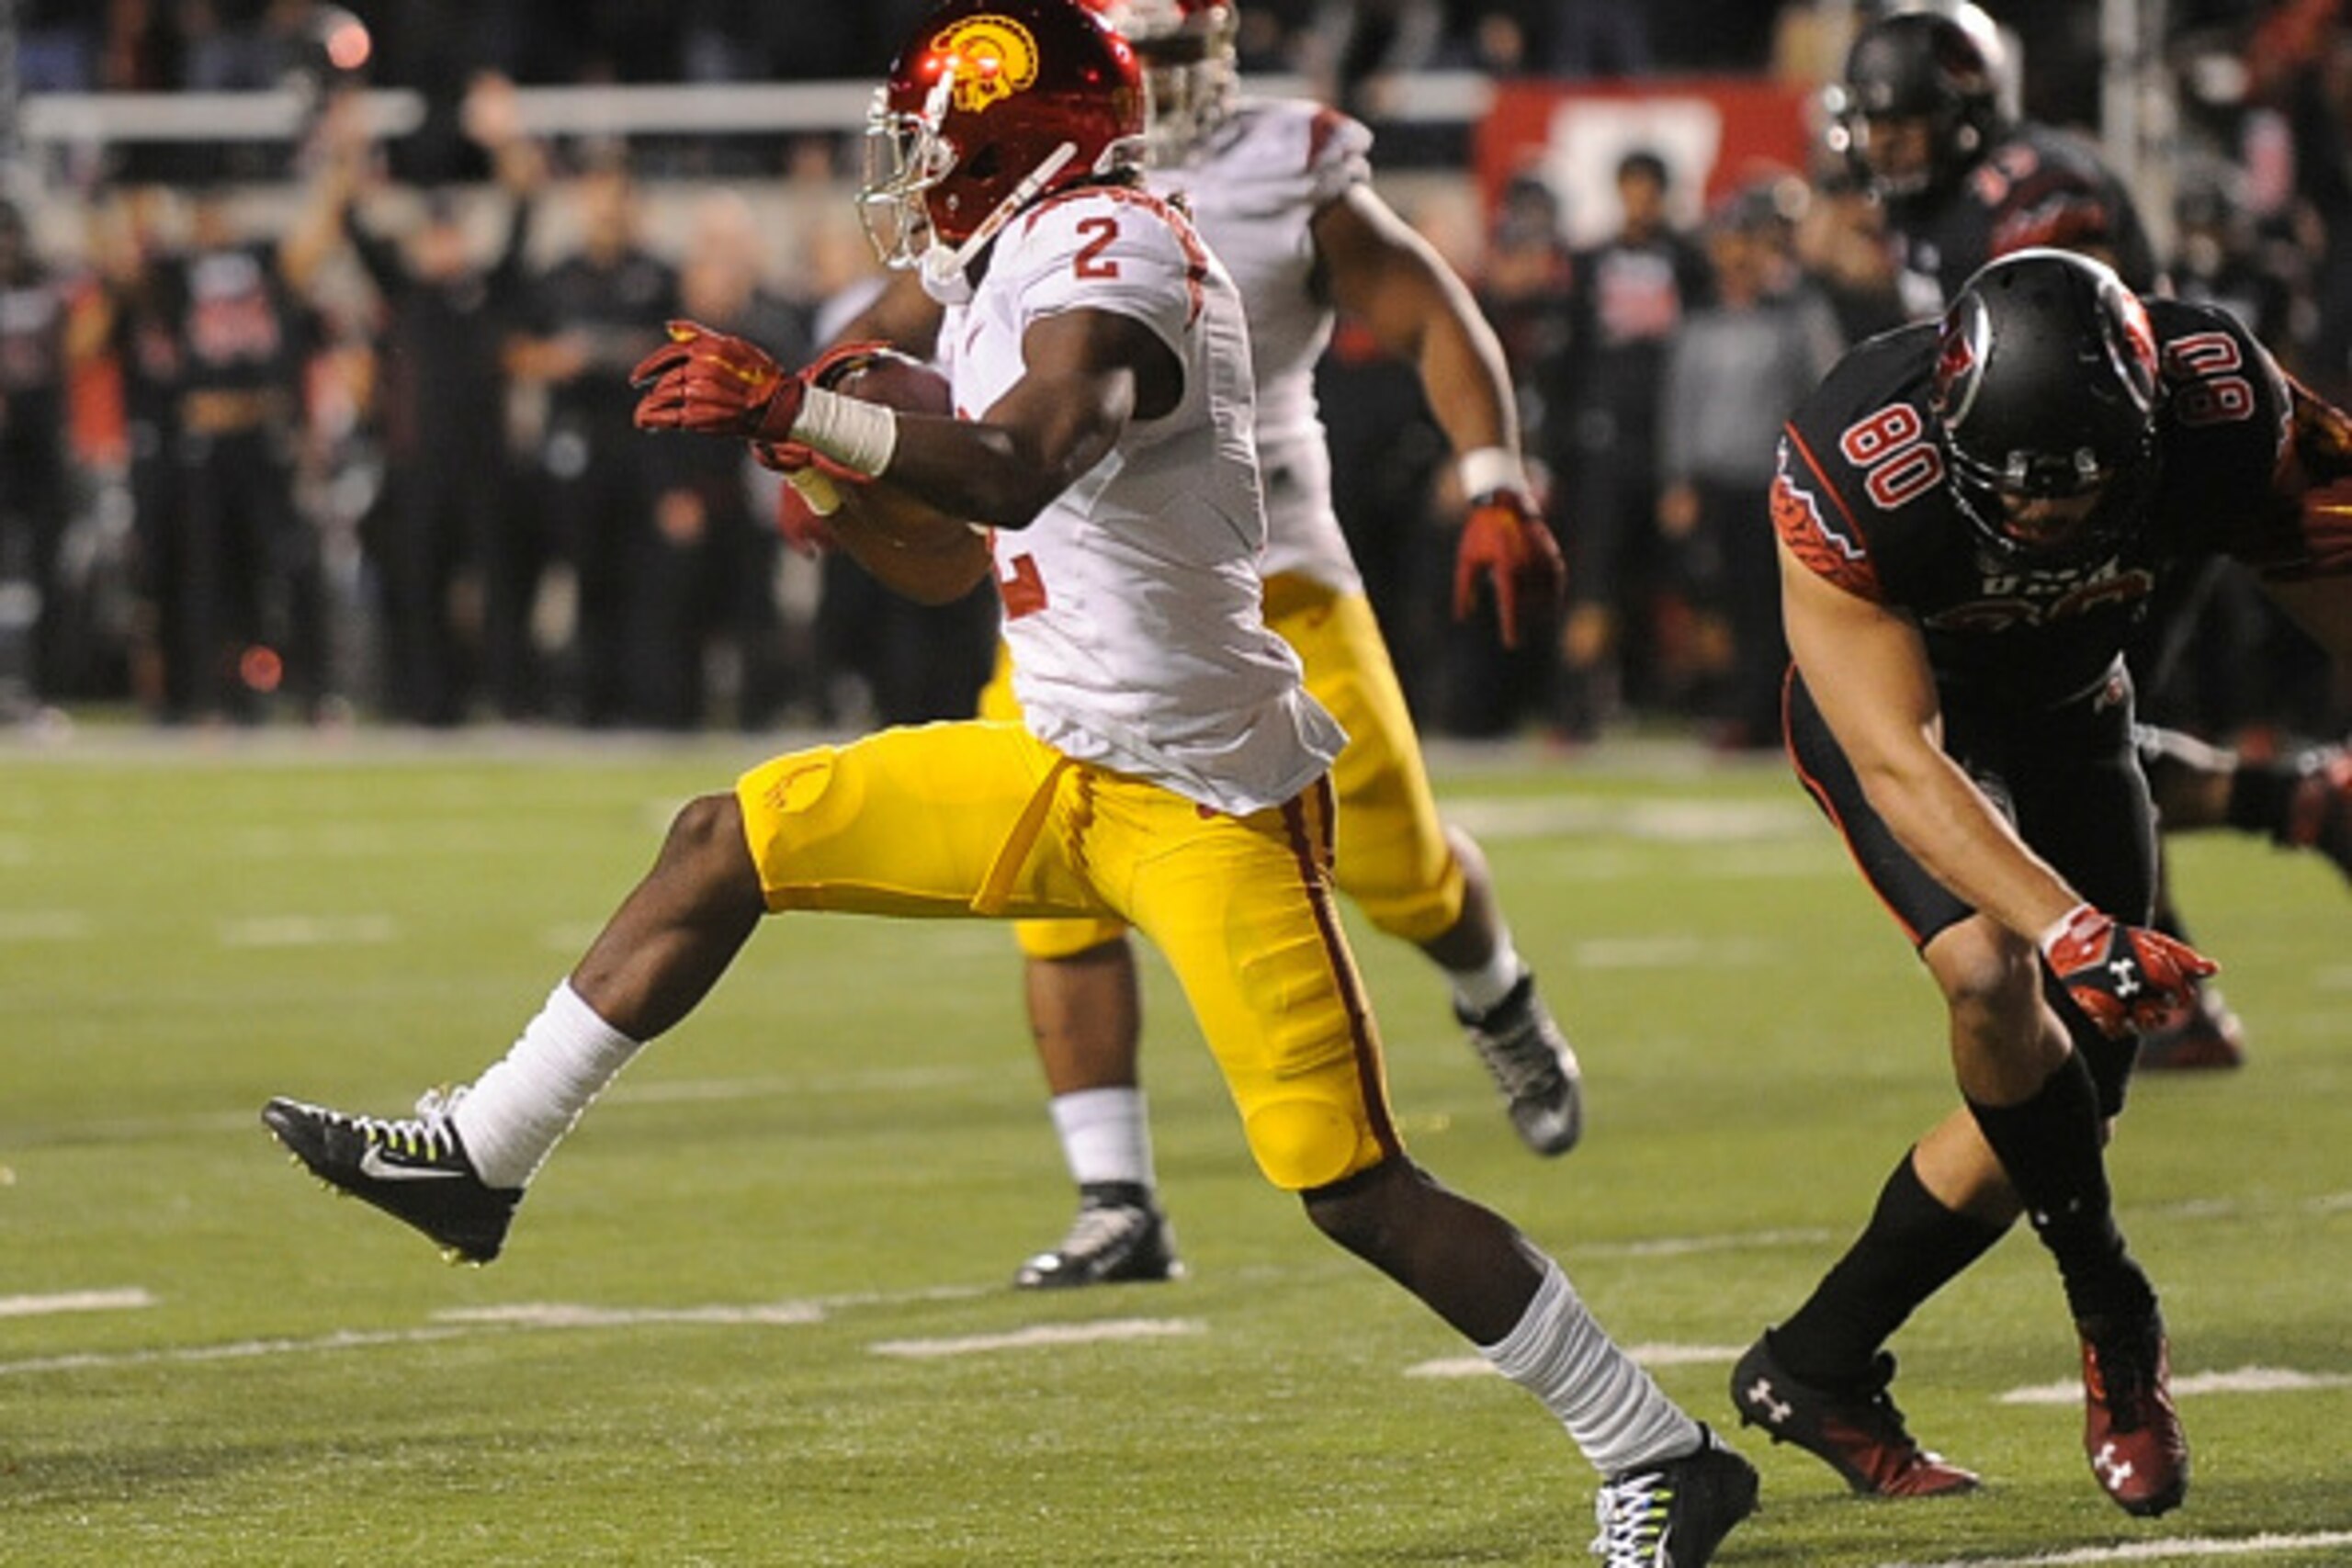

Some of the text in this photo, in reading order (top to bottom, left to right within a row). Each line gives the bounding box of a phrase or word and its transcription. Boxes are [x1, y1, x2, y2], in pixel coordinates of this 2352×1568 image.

[1073, 216, 1120, 279] 2
[2163, 331, 2255, 424] 80
[1839, 402, 1946, 510] 80
